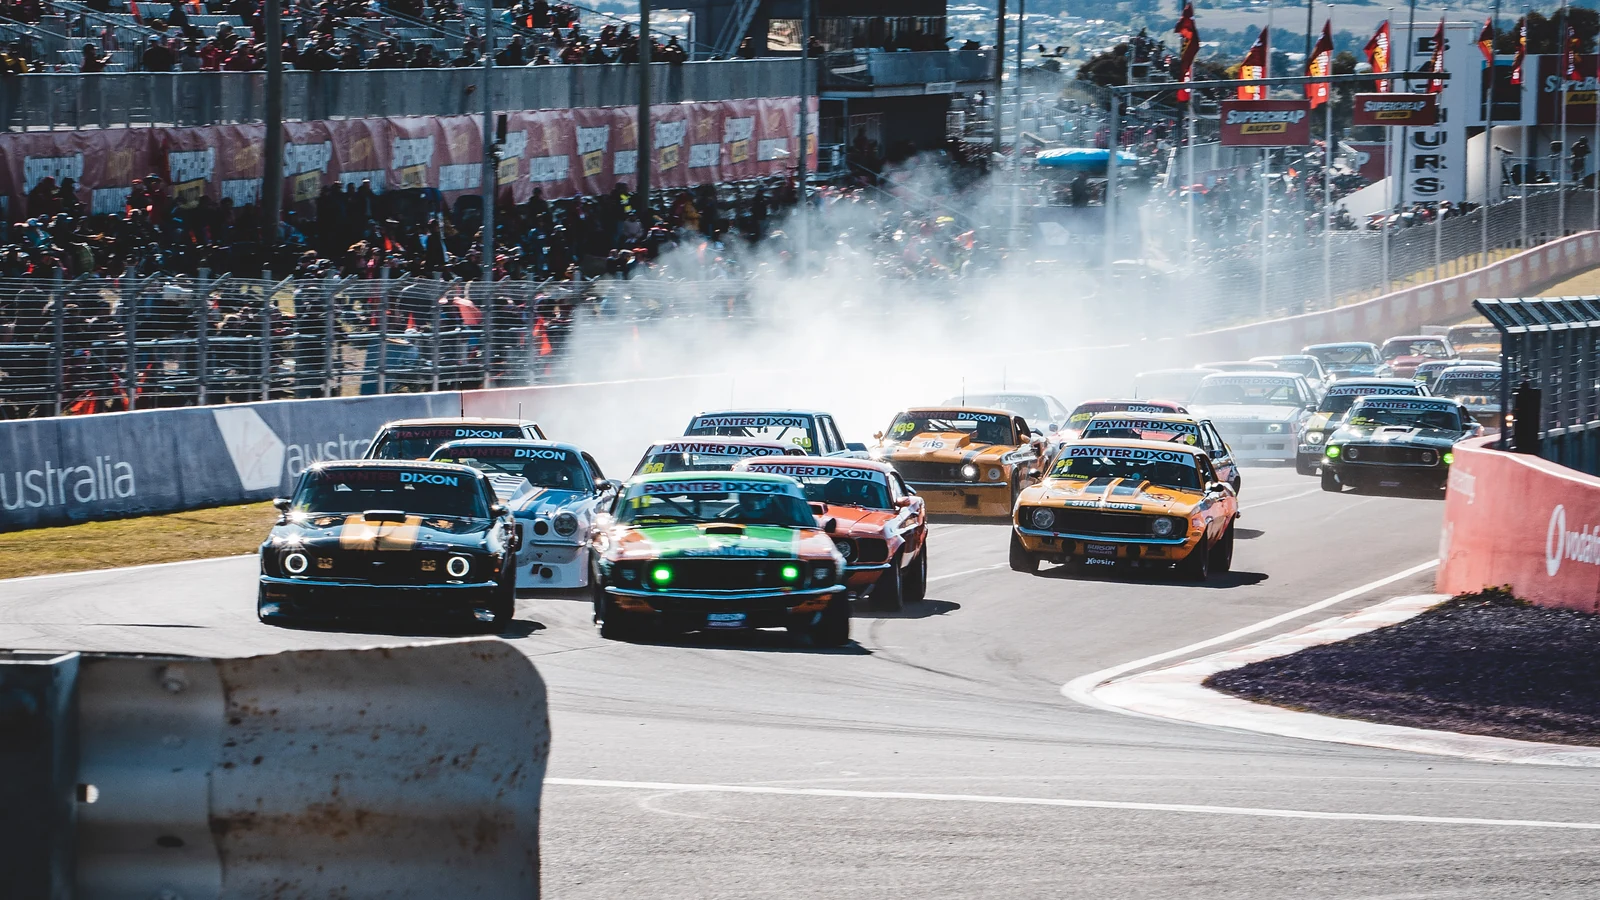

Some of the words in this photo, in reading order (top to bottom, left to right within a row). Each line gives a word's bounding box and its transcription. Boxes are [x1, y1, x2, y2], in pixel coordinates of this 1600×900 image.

[1363, 100, 1427, 113] SUPERCHEAP
[1225, 108, 1307, 125] SUPERCHEAP
[1378, 111, 1409, 119] AUTO
[1245, 122, 1282, 133] AUTO
[1252, 377, 1290, 386] DIXON
[1329, 386, 1377, 396] PAYNTER
[1378, 387, 1418, 396] DIXON
[995, 395, 1029, 403] DIXON
[1127, 405, 1164, 413] DIXON
[1362, 401, 1409, 409] PAYNTER
[1409, 402, 1449, 411] DIXON
[700, 417, 756, 427] PAYNTER
[756, 416, 803, 427] DIXON
[957, 412, 997, 423] DIXON
[1094, 420, 1150, 429] PAYNTER
[1150, 421, 1196, 434] DIXON
[454, 428, 504, 439] DIXON
[450, 447, 513, 458] PAYNTER
[514, 448, 567, 462] DIXON
[661, 443, 726, 454] PAYNTER
[727, 445, 782, 457] DIXO
[1070, 447, 1132, 458] PAYNTER
[1132, 450, 1185, 463] DIXON
[746, 465, 815, 476] PAYNTER
[816, 467, 873, 480] DIXON
[400, 471, 459, 487] DIXON
[643, 480, 723, 493] PAYNTER
[725, 480, 789, 493] DIXON
[1071, 499, 1137, 510] SHANNONS
